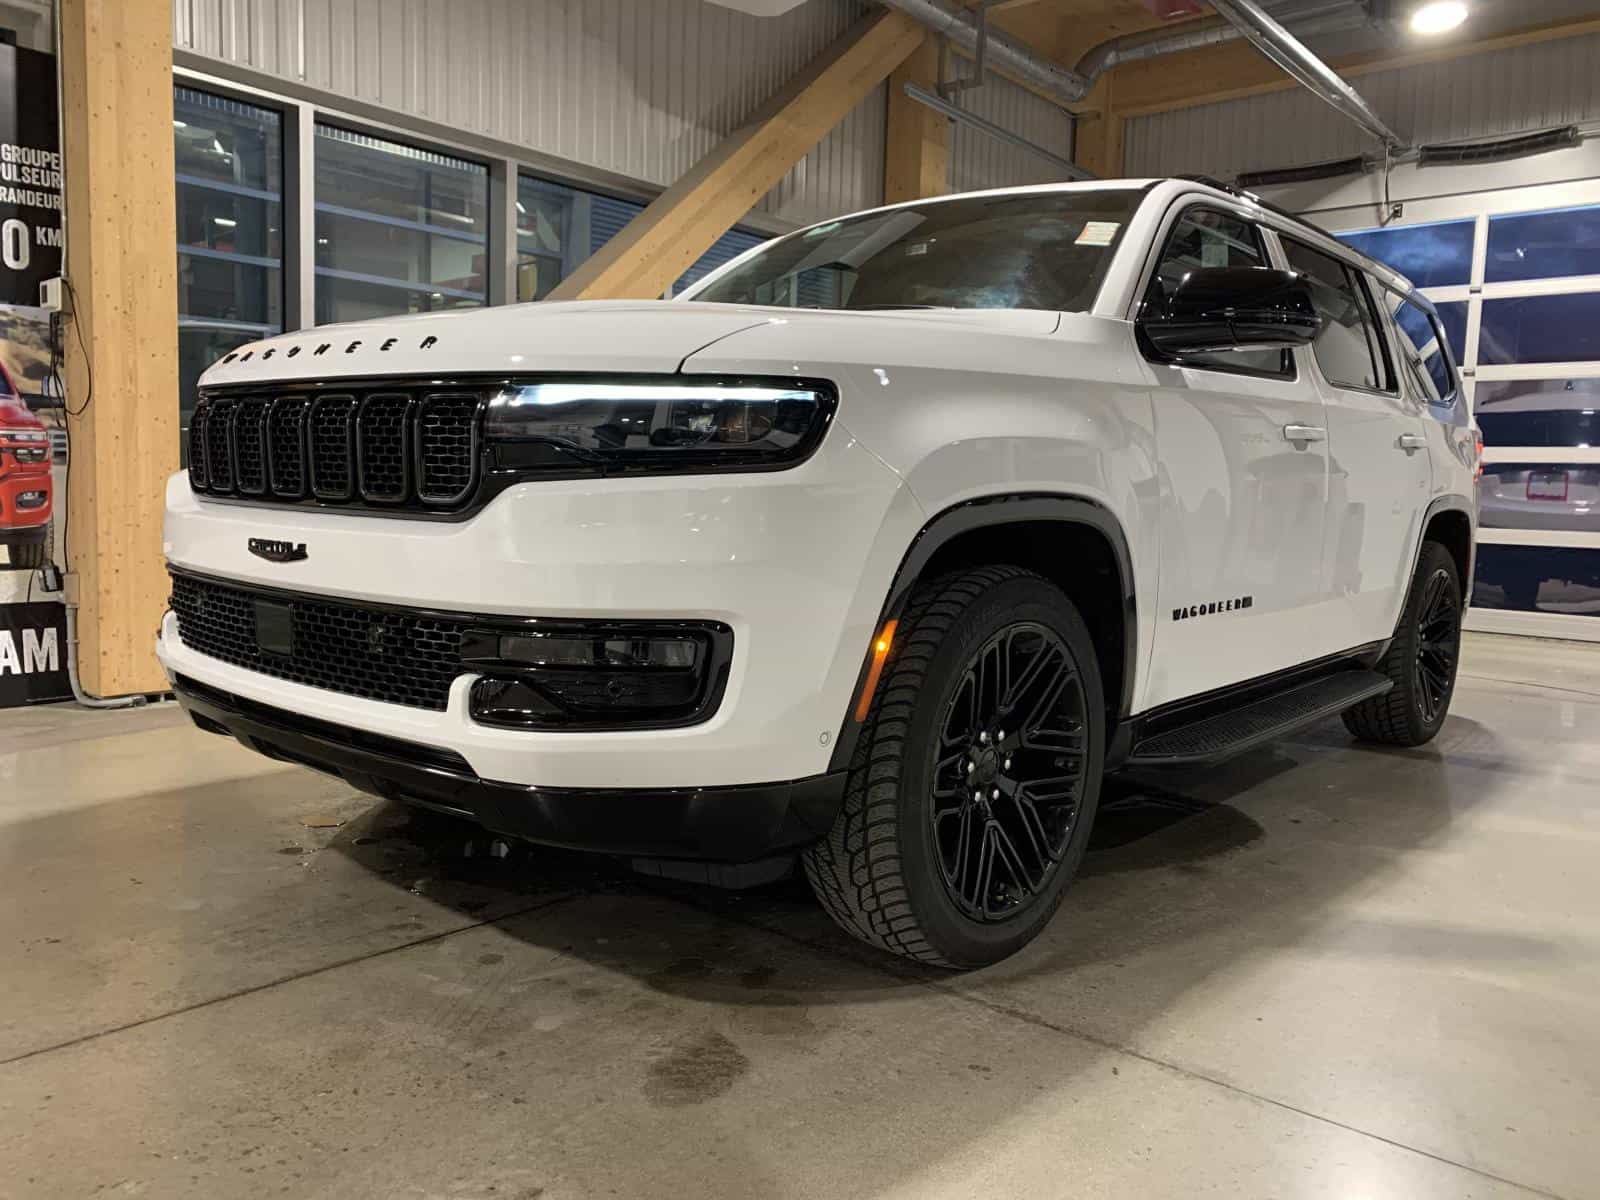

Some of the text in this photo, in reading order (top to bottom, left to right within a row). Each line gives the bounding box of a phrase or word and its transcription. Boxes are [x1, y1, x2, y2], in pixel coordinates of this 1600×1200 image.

[1, 143, 60, 171] GROUPE
[0, 162, 60, 189] ULSEUR
[35, 225, 61, 247] KM
[222, 335, 438, 364] WAGONEER
[1172, 598, 1241, 621] WAGONEER
